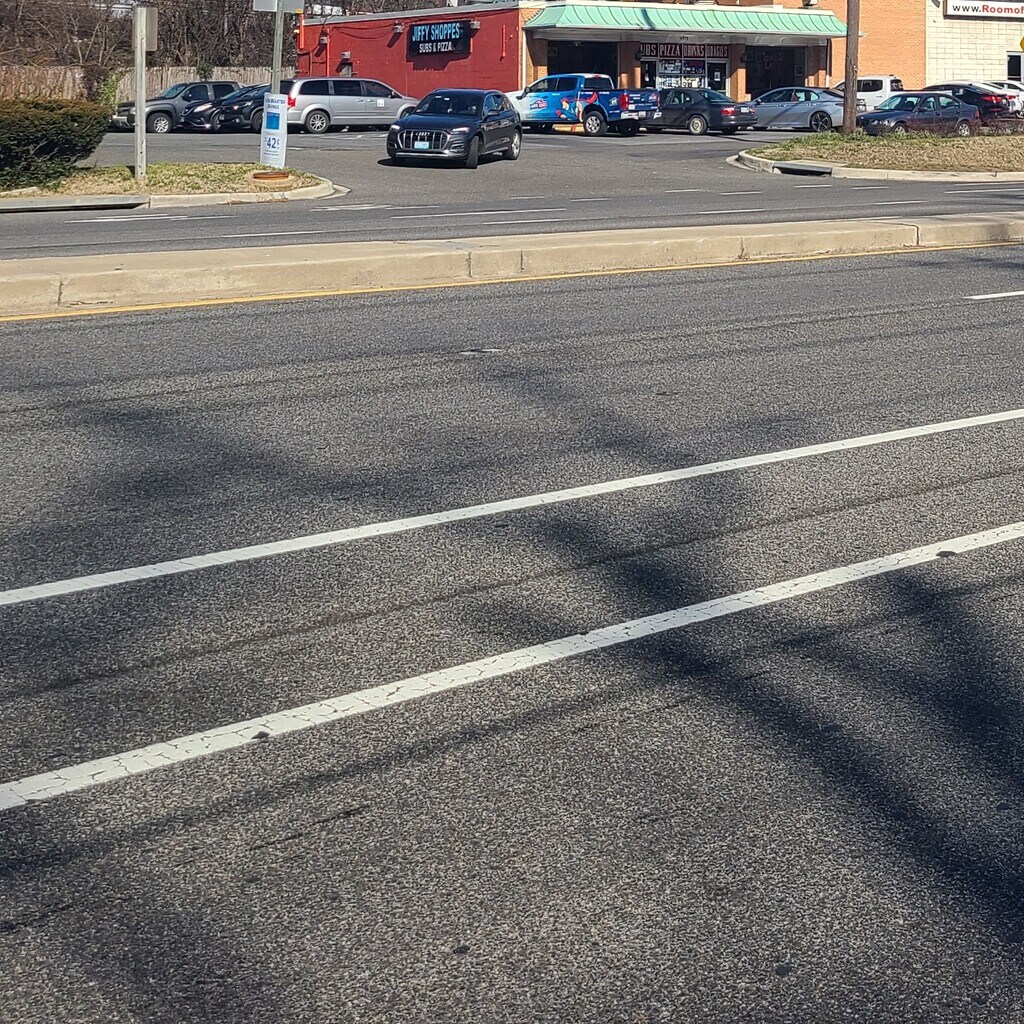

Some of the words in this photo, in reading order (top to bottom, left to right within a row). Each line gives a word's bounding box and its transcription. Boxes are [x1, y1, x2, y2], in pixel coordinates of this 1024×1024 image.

[412, 25, 430, 42] JIFFY
[431, 23, 460, 41] SHOPPES
[419, 42, 433, 53] SUBS
[437, 41, 452, 52] PIZZA
[640, 44, 656, 56] UBS
[660, 44, 681, 56] PIZZA
[684, 45, 705, 57] DRINKS
